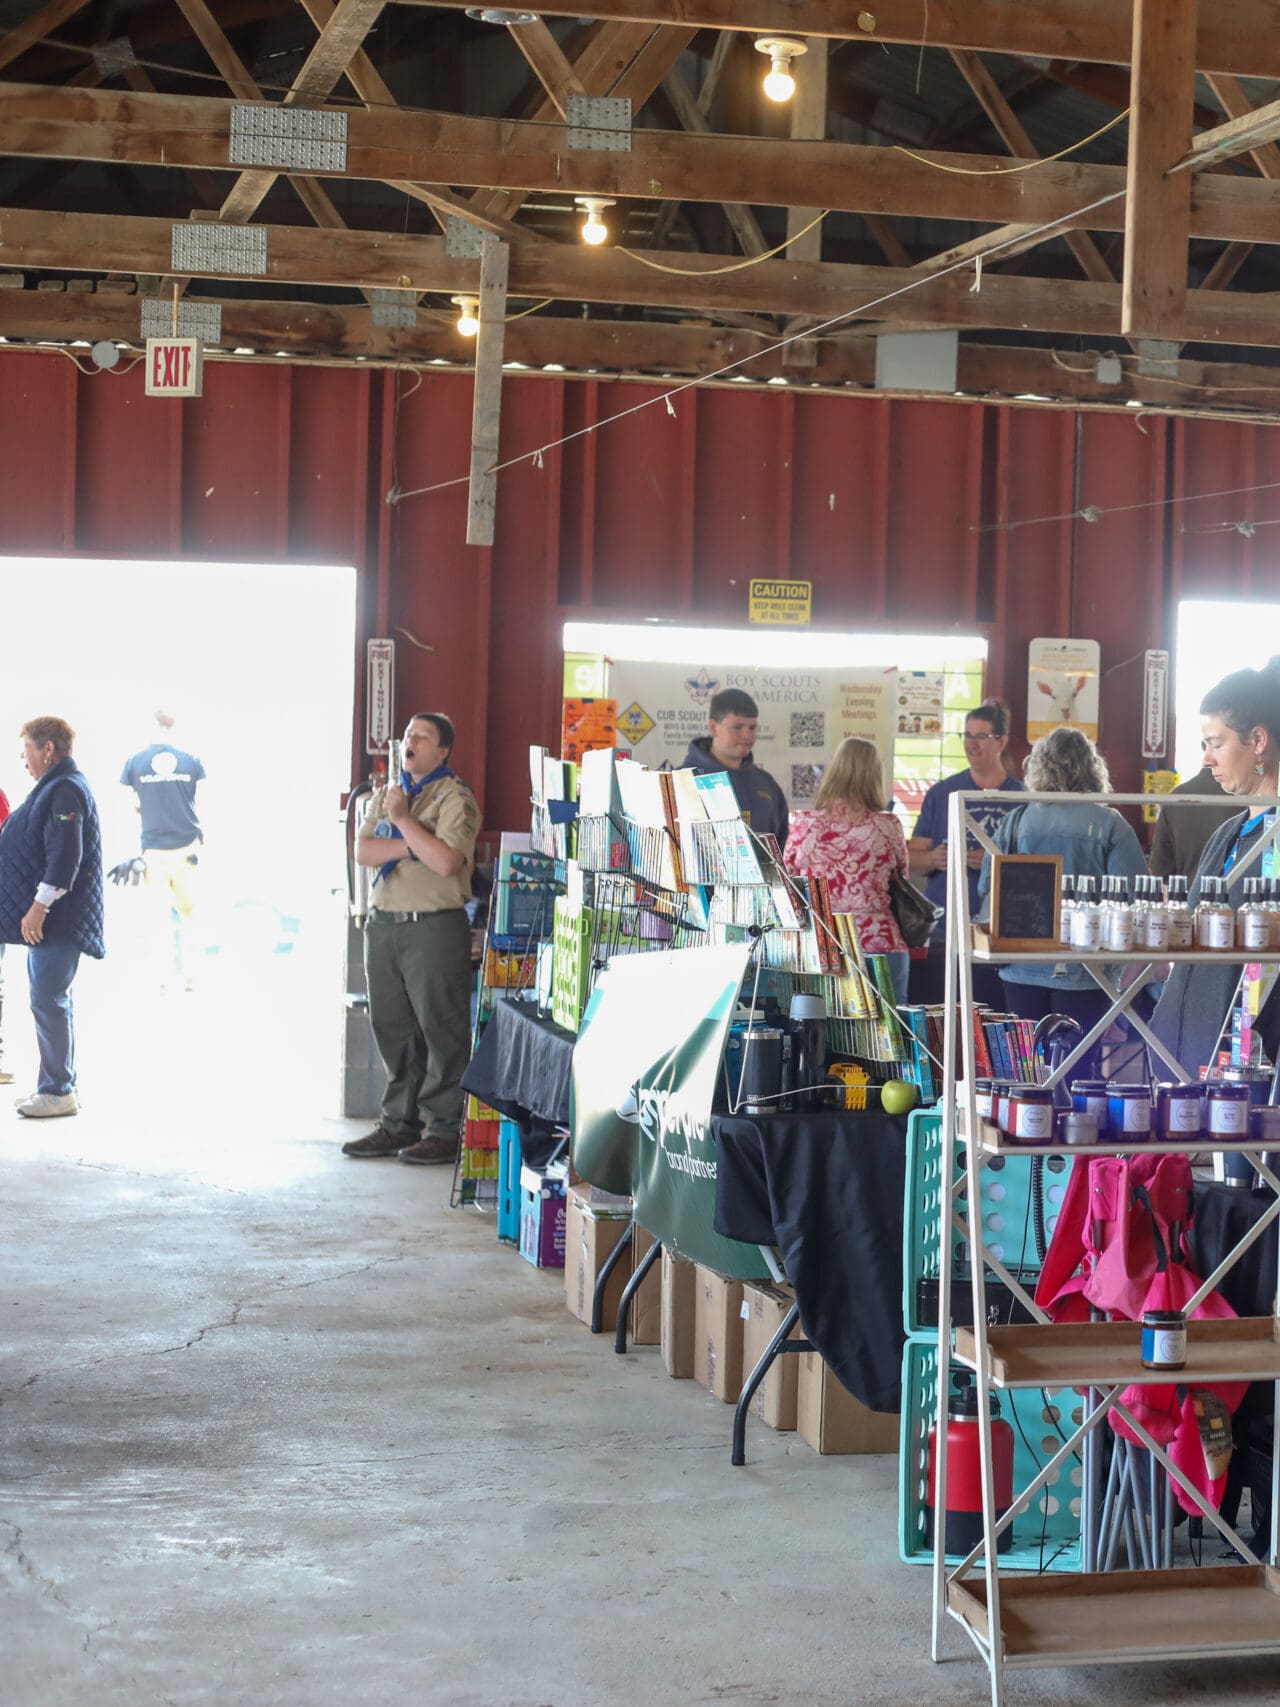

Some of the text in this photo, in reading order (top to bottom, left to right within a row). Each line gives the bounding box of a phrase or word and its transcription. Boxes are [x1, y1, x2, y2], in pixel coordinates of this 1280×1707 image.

[153, 346, 191, 387] EXIT
[754, 584, 807, 598] CAUTION
[372, 650, 389, 660] FIRE
[1148, 660, 1165, 670] FIRE
[726, 674, 821, 687] BOY SCOUTS
[753, 690, 819, 703] AMERICA
[657, 710, 707, 721] CUB SCOUT
[842, 710, 876, 720] Meetings
[1152, 672, 1160, 747] EXTINGUISHER
[665, 1146, 690, 1173] brand
